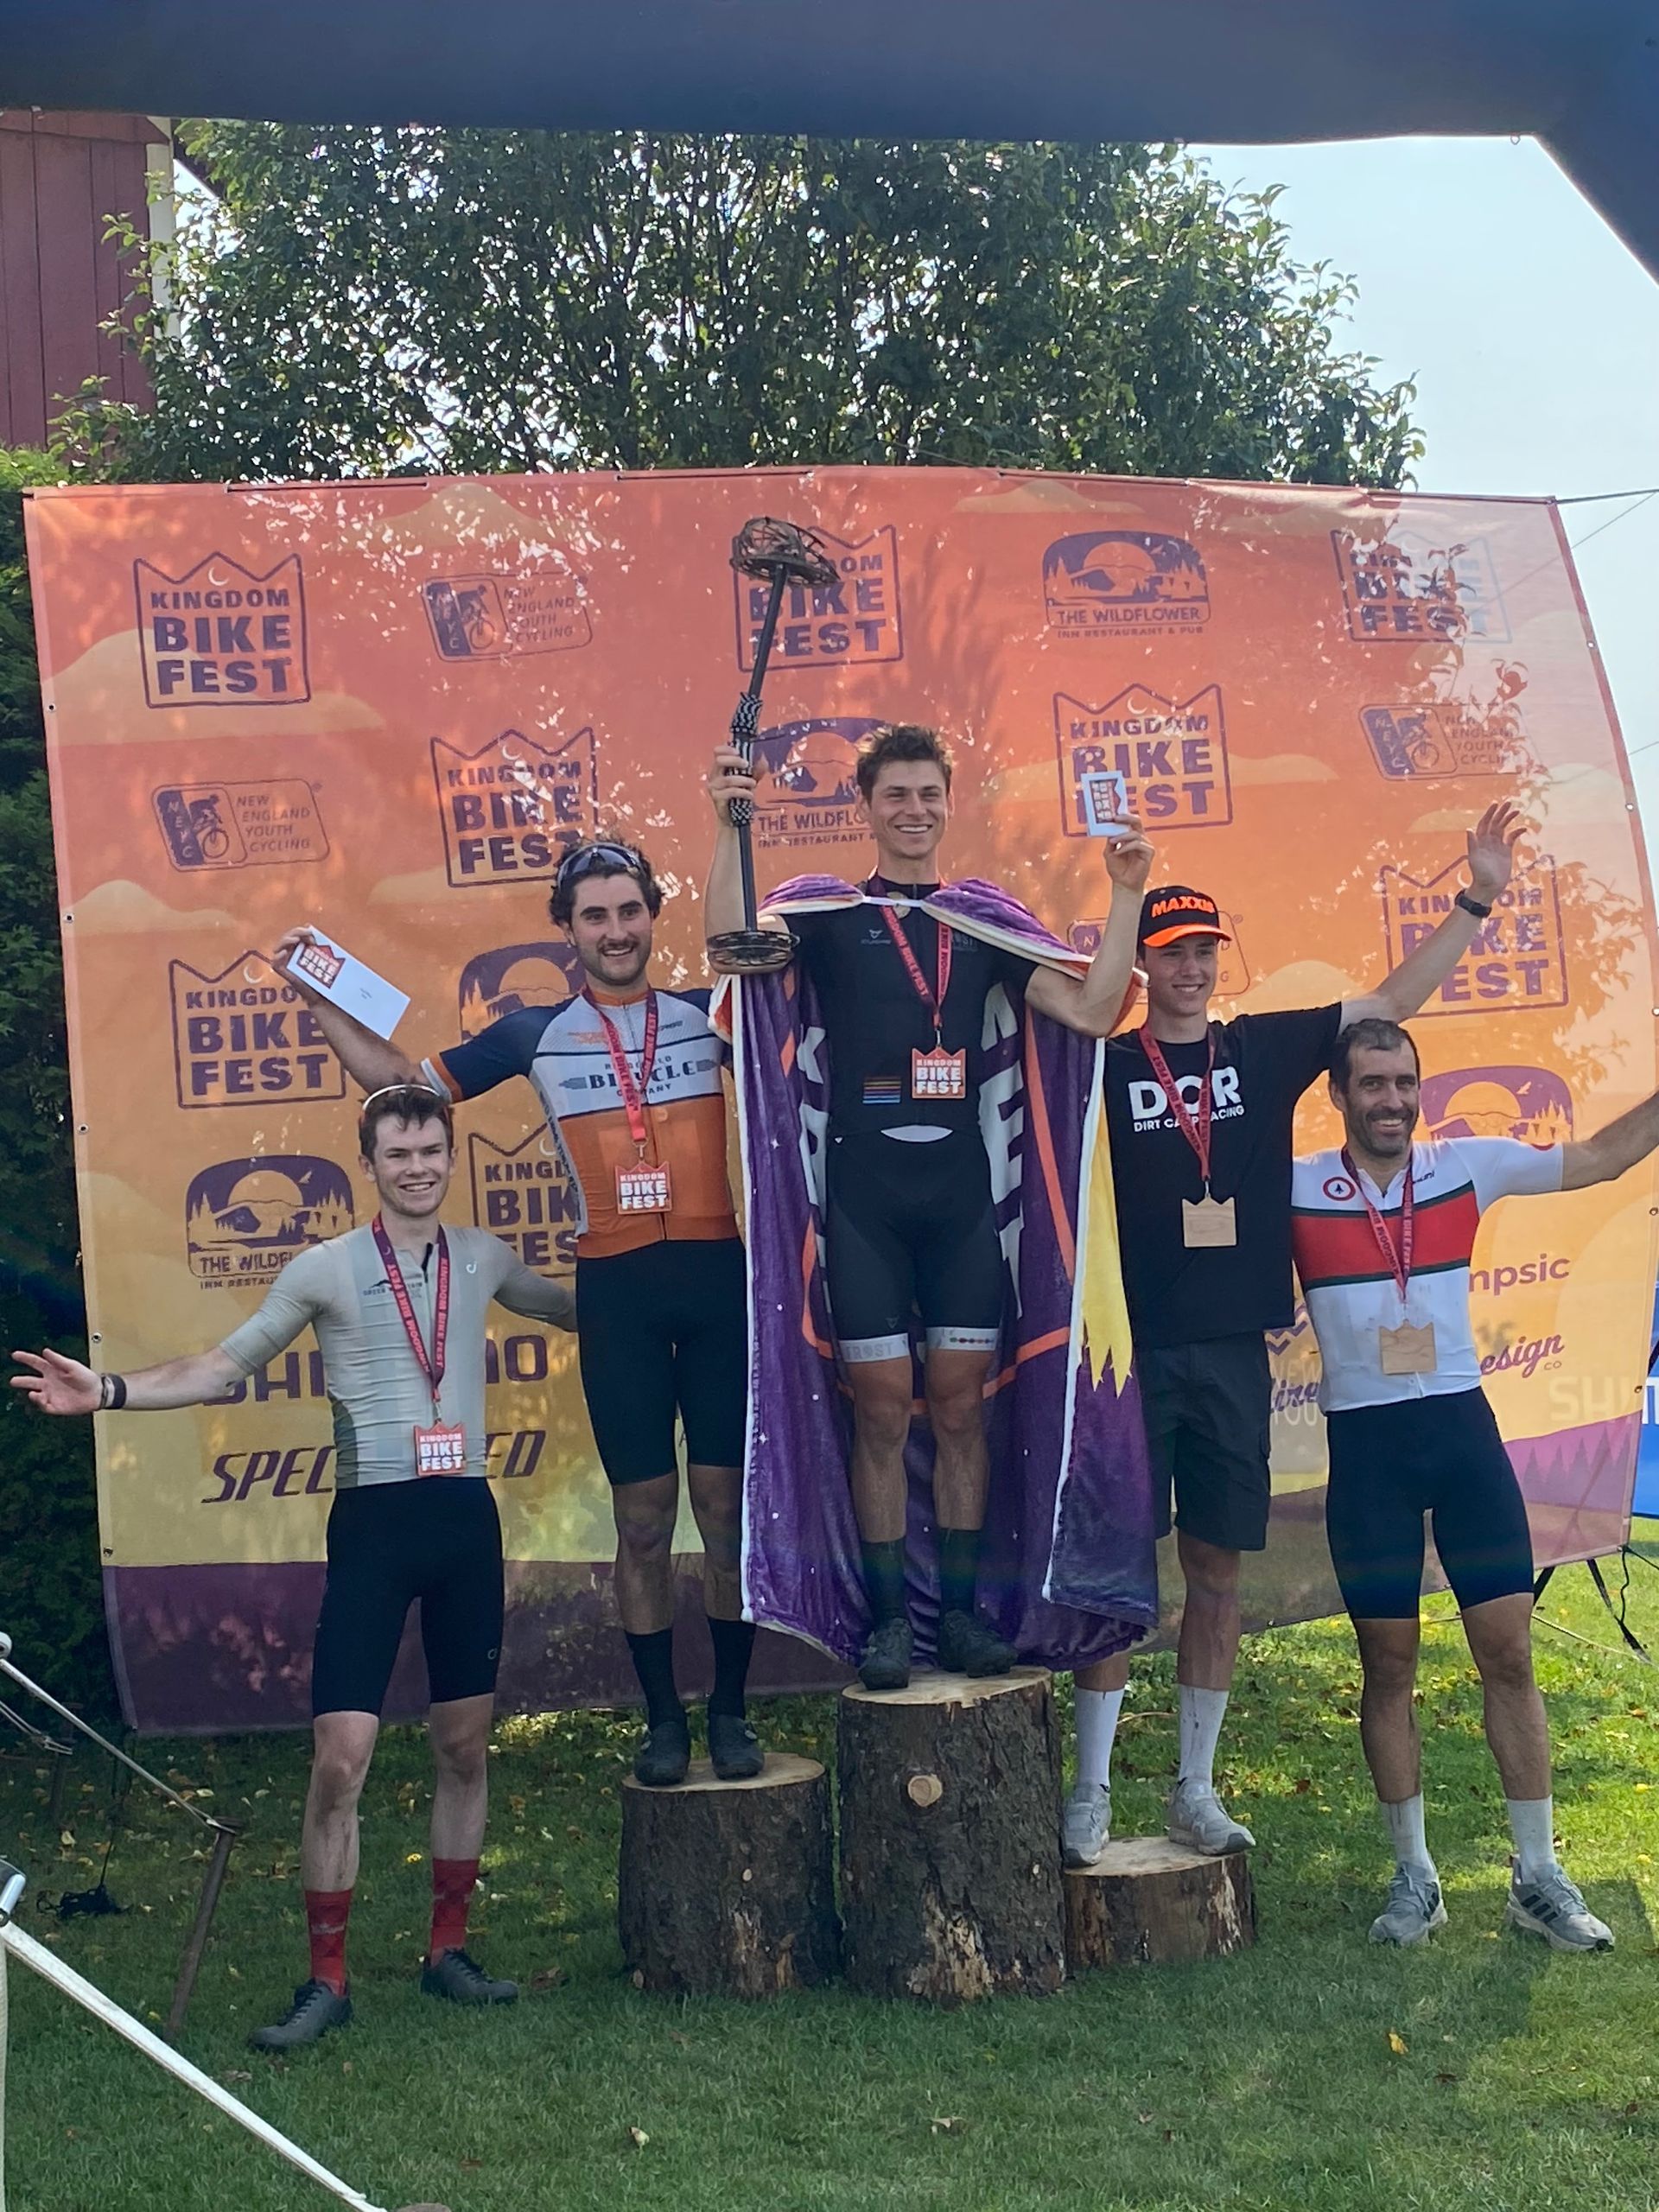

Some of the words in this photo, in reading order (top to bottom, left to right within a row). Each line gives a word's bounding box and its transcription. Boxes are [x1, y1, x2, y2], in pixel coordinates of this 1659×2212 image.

[151, 588, 289, 609] KINGDOM
[749, 578, 885, 621] BIKE
[512, 614, 556, 629] OUTH
[1058, 609, 1087, 625] THE
[1093, 607, 1200, 623] WILDFLOWER
[153, 614, 291, 653] BIKE
[1058, 629, 1080, 639] INN
[1084, 627, 1162, 638] RESTAURANT
[1179, 626, 1203, 634] PUB
[156, 657, 292, 695] FEST
[1072, 739, 1212, 782] BIKE
[1460, 753, 1507, 765] CYCLI
[448, 761, 582, 787] KINGOM
[237, 794, 270, 807] NEW
[452, 785, 583, 832] BIKE
[242, 807, 311, 822] ENGLAND
[758, 814, 788, 831] THE
[794, 810, 865, 830] WILDFLO
[245, 824, 293, 837] YOUTH
[250, 839, 311, 853] CYCLING
[1398, 888, 1542, 916] KINOM
[1400, 913, 1547, 961] BKE
[1441, 959, 1549, 1002] EST
[186, 986, 298, 1009] KINGDO
[188, 1009, 329, 1054] BIKE
[191, 1054, 328, 1096] FEST
[589, 1060, 696, 1090] BICLE
[917, 1066, 961, 1080] BIKE
[616, 1083, 671, 1096] CANY
[917, 1081, 962, 1094] FEST
[1134, 1119, 1160, 1133] DIRT
[1164, 1116, 1199, 1128] CAP
[1211, 1105, 1245, 1122] ACING
[620, 1172, 666, 1182] KINGDOM
[620, 1180, 667, 1196] BIKE
[486, 1185, 577, 1227] BIK
[621, 1194, 667, 1210] FEST
[495, 1230, 577, 1266] ES
[200, 1255, 231, 1274] THE
[239, 1251, 293, 1271] WILDF
[200, 1281, 223, 1289] INN
[227, 1276, 278, 1288] RESTAU
[1480, 1333, 1565, 1378] esign
[420, 1441, 463, 1457] BIKE
[421, 1455, 463, 1471] FEST
